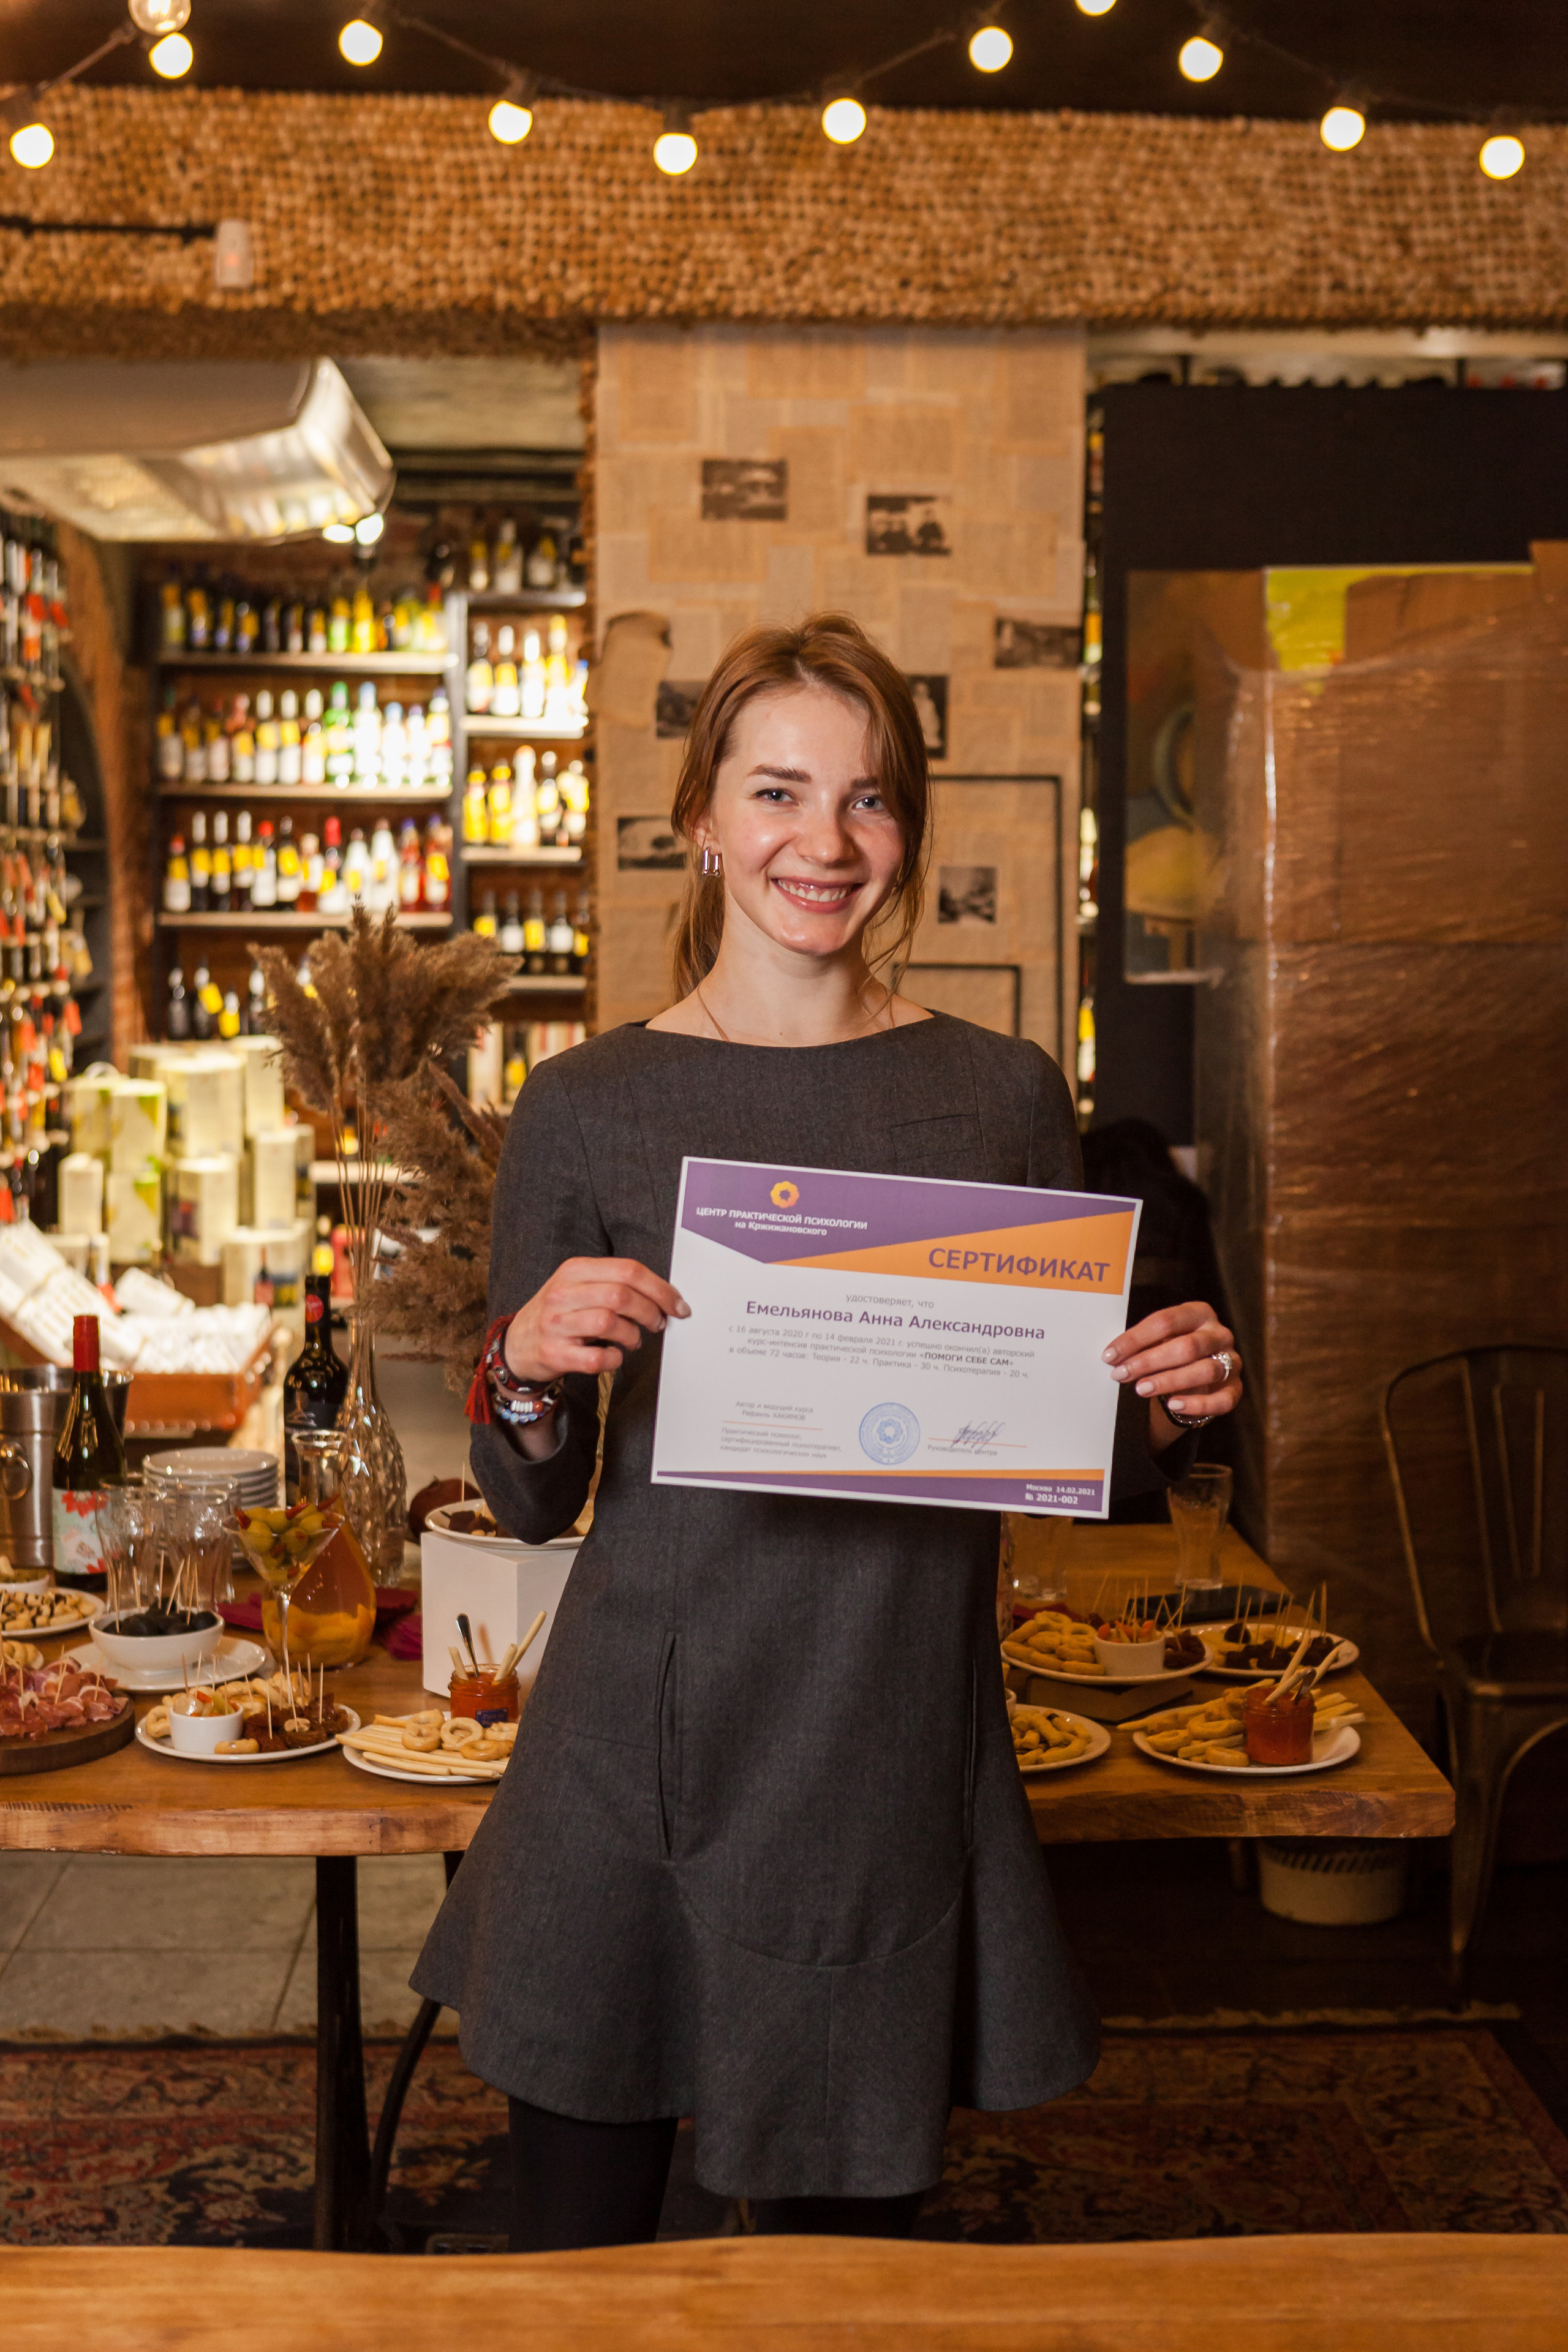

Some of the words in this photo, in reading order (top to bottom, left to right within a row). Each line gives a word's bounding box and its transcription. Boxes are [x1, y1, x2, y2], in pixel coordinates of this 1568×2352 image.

[696, 1207, 727, 1217] ЦЕНТР
[728, 1210, 802, 1224] ПРАКТИЧЕСКОЙ
[804, 1216, 867, 1230] ПСИХОЛОГИИ
[748, 1222, 827, 1236] Кржижановского
[928, 1247, 1110, 1283] СЕРТИФИКАТ
[845, 1294, 914, 1308] удостоверяет,
[746, 1301, 853, 1322] Емельянова
[859, 1311, 903, 1326] Анна
[908, 1316, 1045, 1340] Александровна
[748, 1327, 780, 1336] августа
[782, 1329, 803, 1338] 2020
[838, 1334, 873, 1344] февраля
[876, 1337, 895, 1346] 2021
[907, 1341, 942, 1351] успешно
[944, 1343, 990, 1355] окончил(а)
[993, 1348, 1035, 1358] авторский
[748, 1338, 807, 1348] курс-интенсив
[810, 1343, 866, 1354] практической
[869, 1348, 916, 1358] психологии
[919, 1351, 962, 1362] «ПОМОГИ
[990, 1357, 1014, 1366] САМ»
[736, 1346, 767, 1355] объеме
[812, 1352, 840, 1363] Теория
[873, 1357, 911, 1368] Практика
[943, 1363, 1001, 1376] Психотерапия
[772, 1412, 805, 1420] ХАКИМОВ
[1025, 1483, 1052, 1492] Москва
[1056, 1485, 1095, 1495] 14.02.2021
[1036, 1493, 1079, 1504] 2021-002
